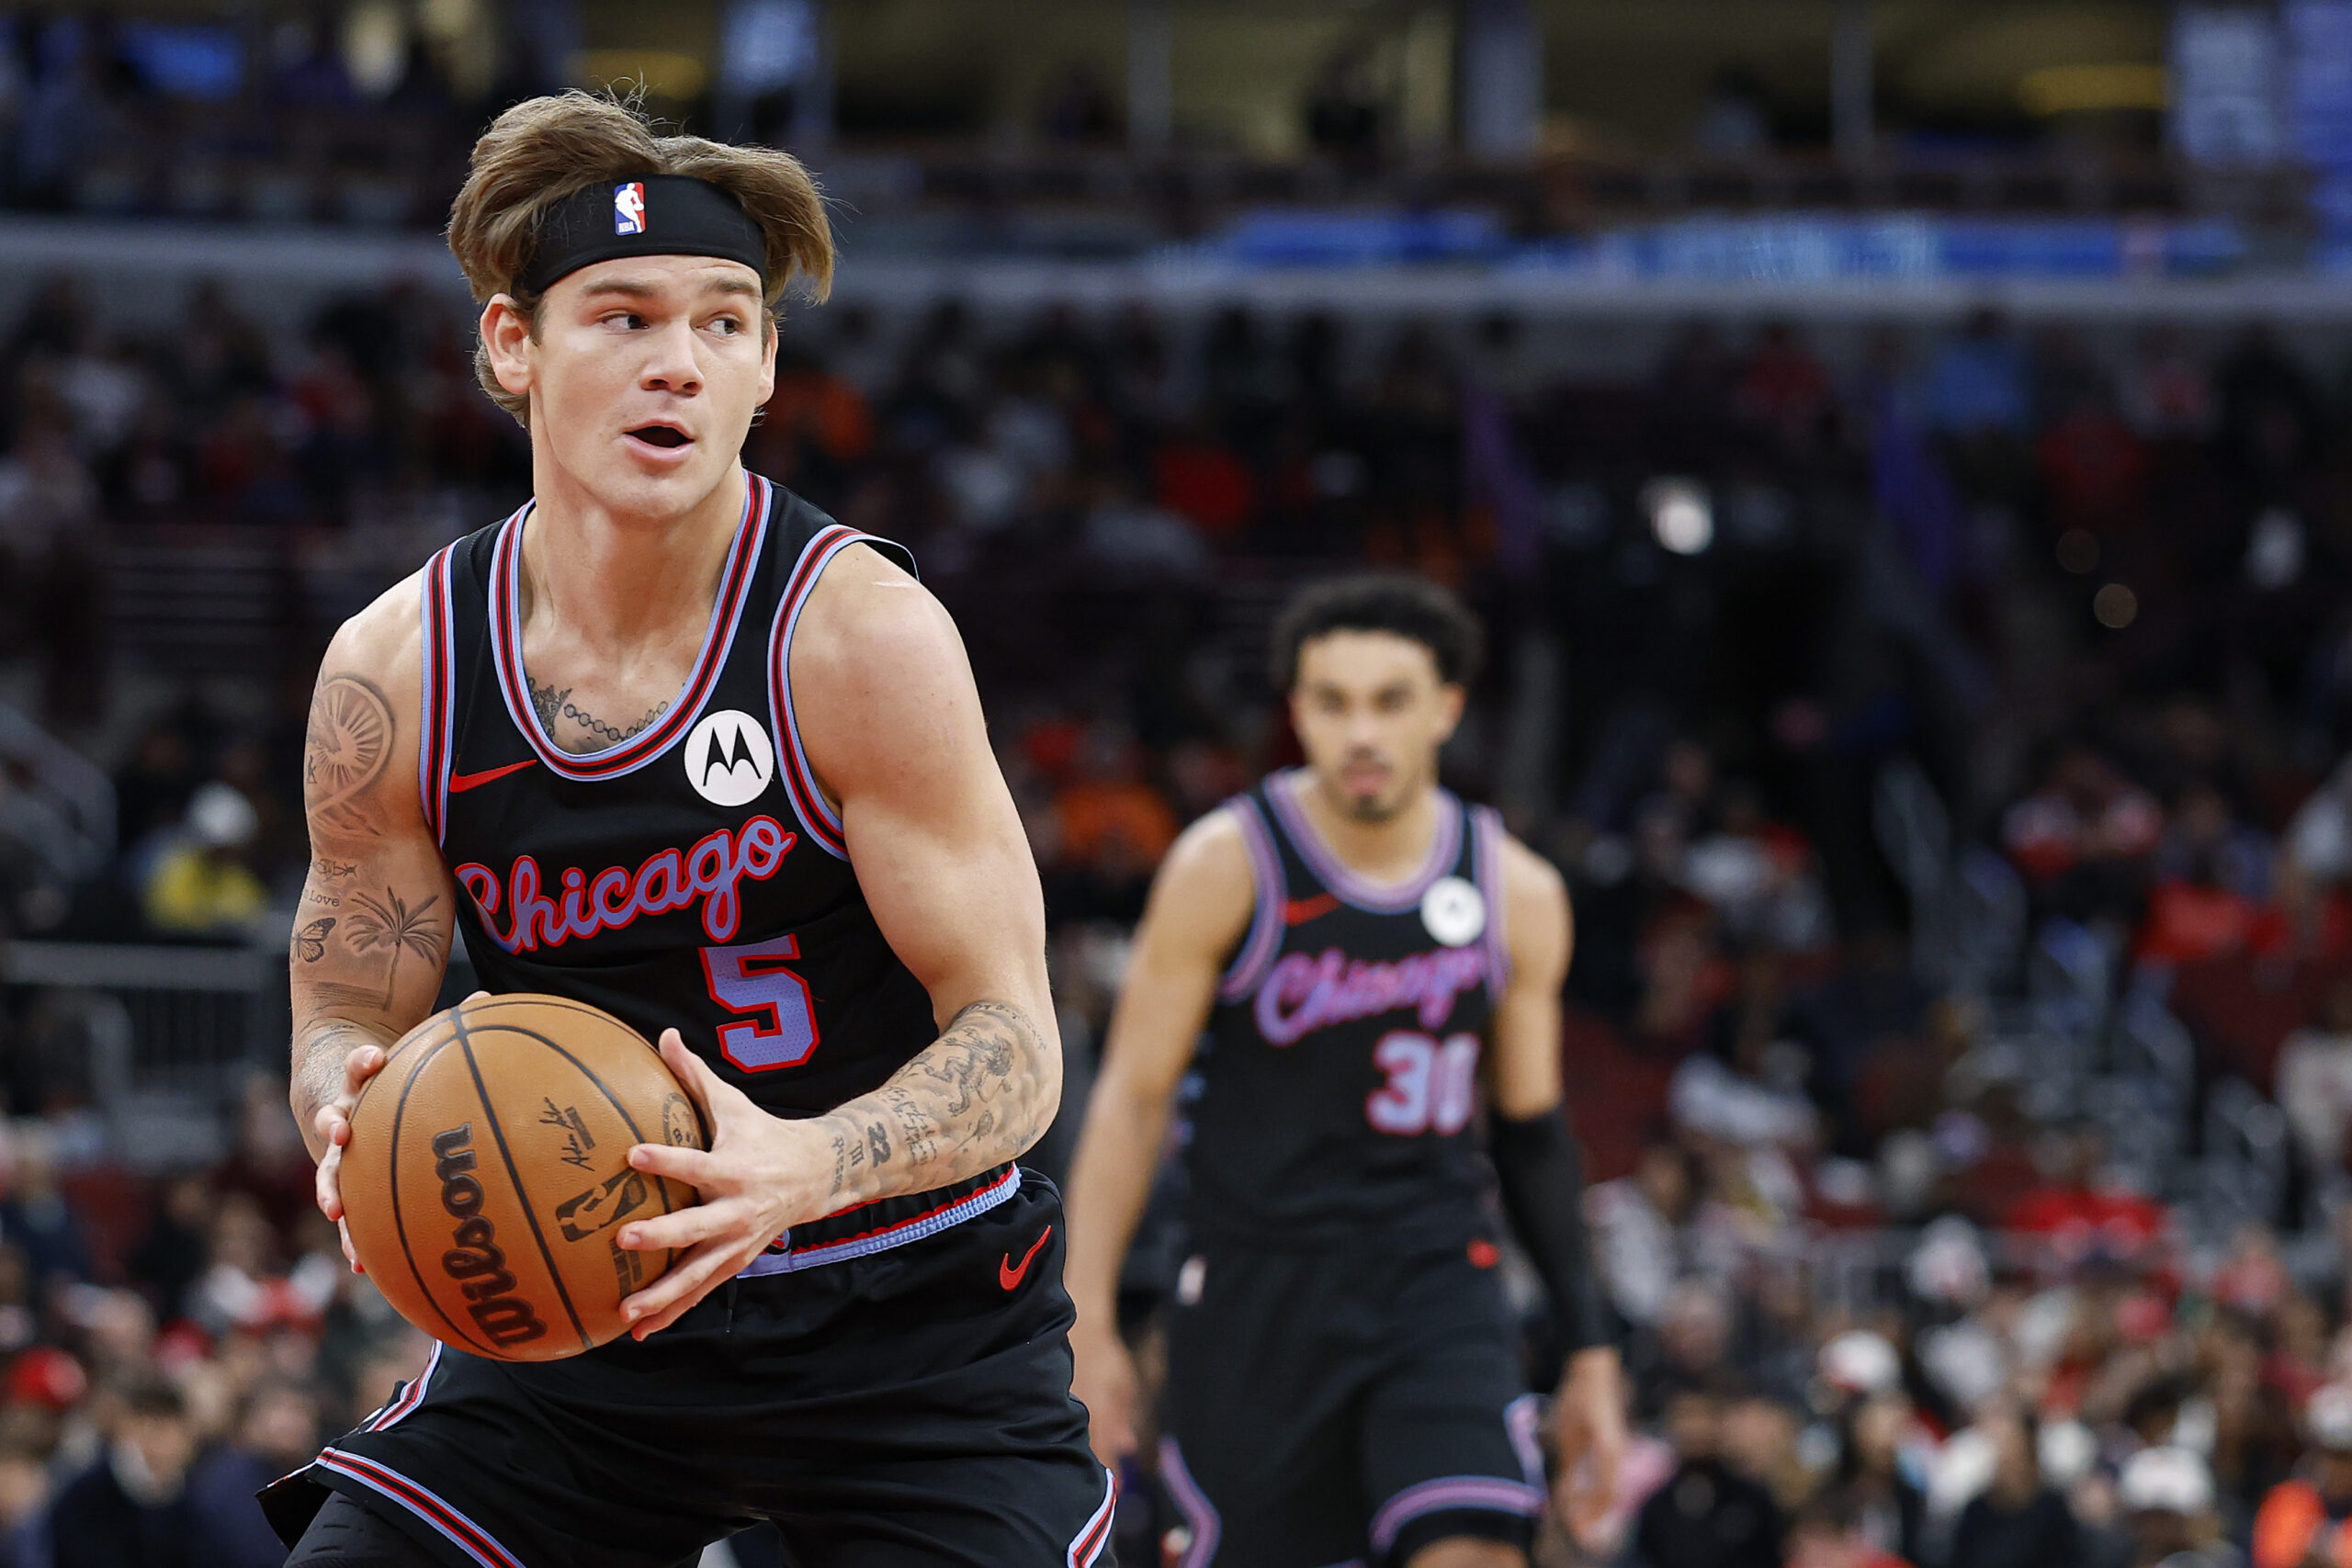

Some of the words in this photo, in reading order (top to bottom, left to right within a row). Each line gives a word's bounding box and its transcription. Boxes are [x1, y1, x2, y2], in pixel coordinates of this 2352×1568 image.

[618, 221, 635, 233] NBA
[455, 815, 797, 955] Chicago
[698, 933, 820, 1075] 5
[431, 1122, 548, 1348] Wilson
